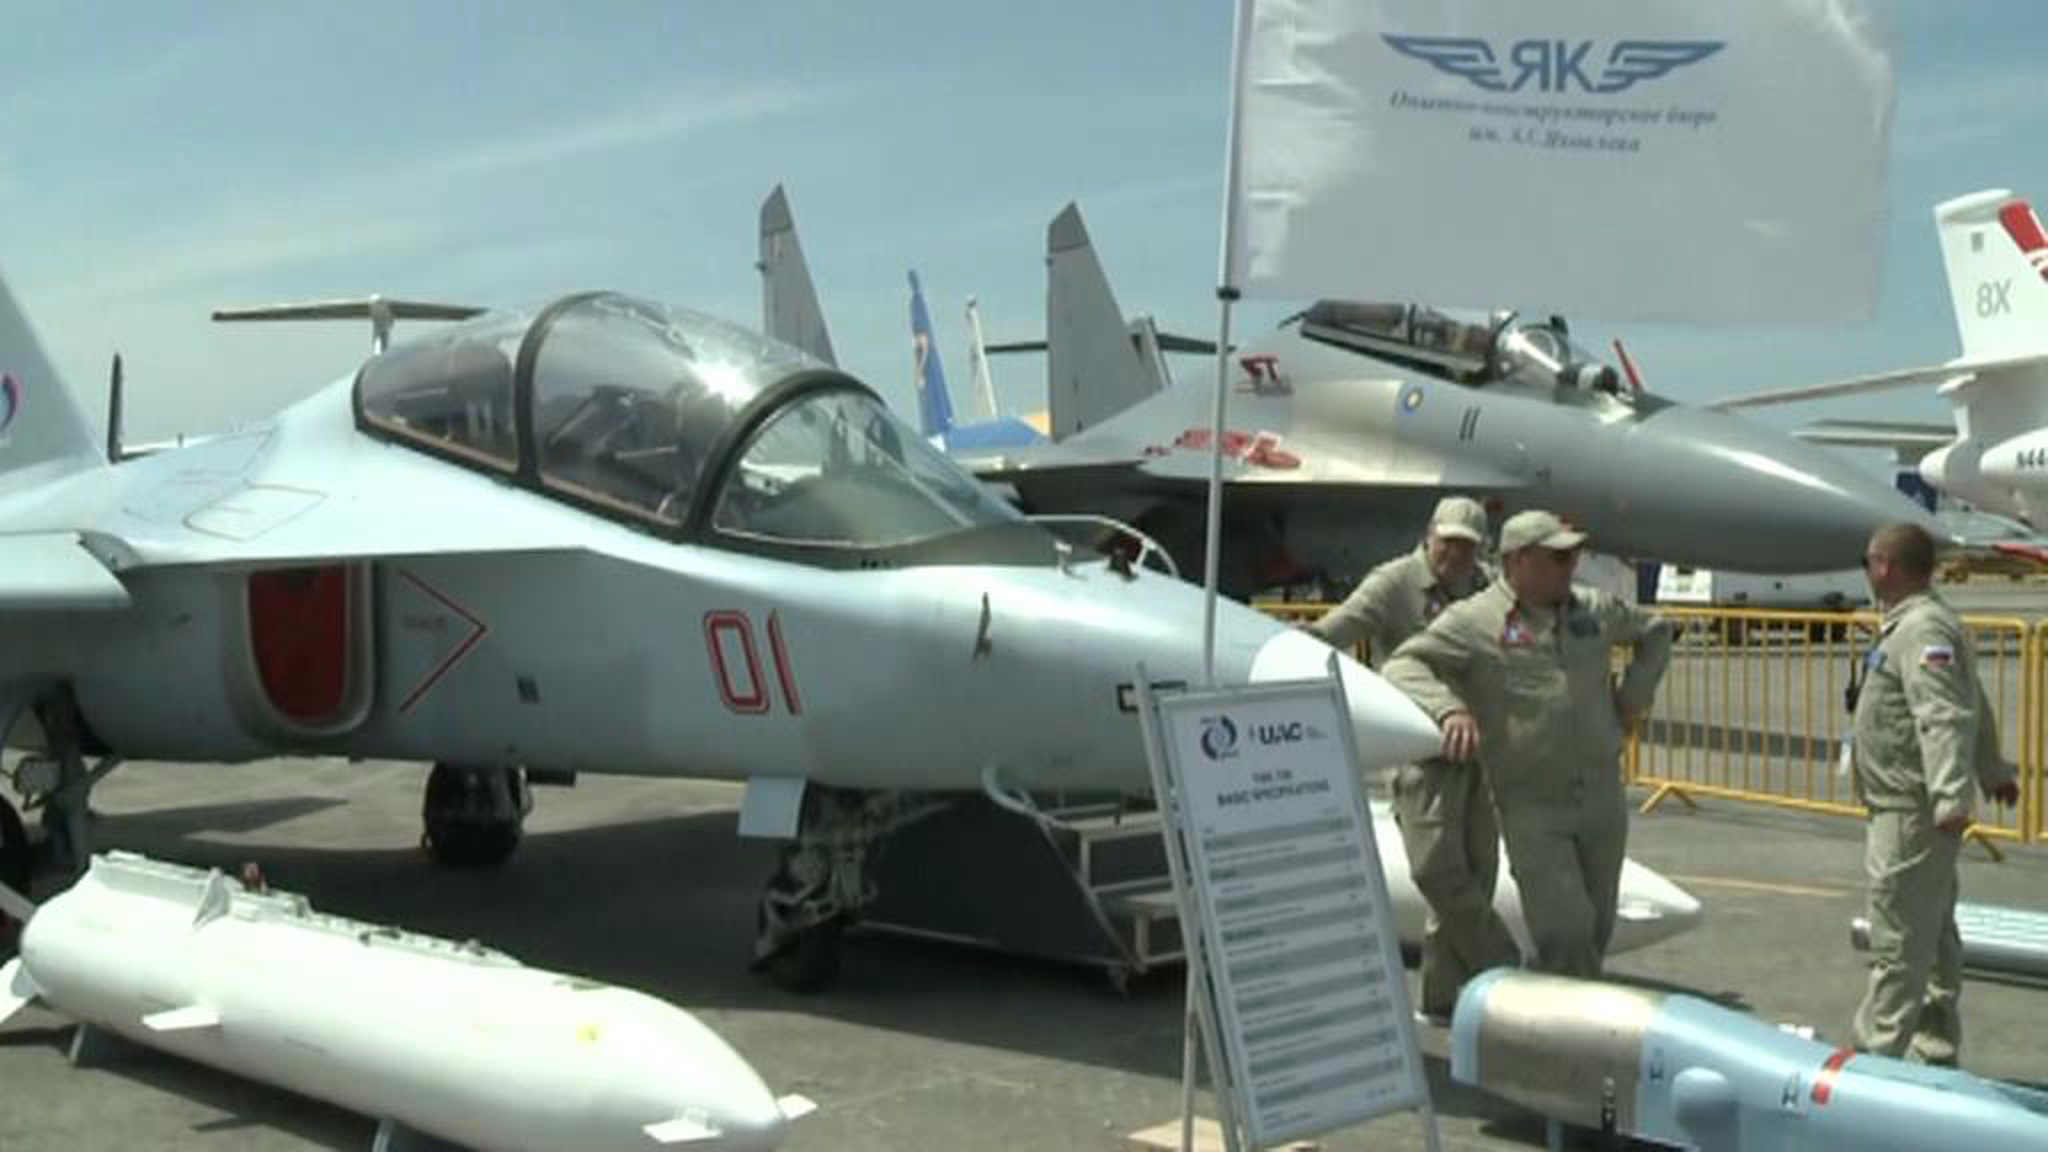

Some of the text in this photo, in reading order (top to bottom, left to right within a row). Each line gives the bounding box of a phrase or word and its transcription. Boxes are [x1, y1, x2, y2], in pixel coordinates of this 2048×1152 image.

[1510, 40, 1595, 92] ЯК
[1975, 278, 2012, 319] 8X
[703, 607, 802, 716] 01
